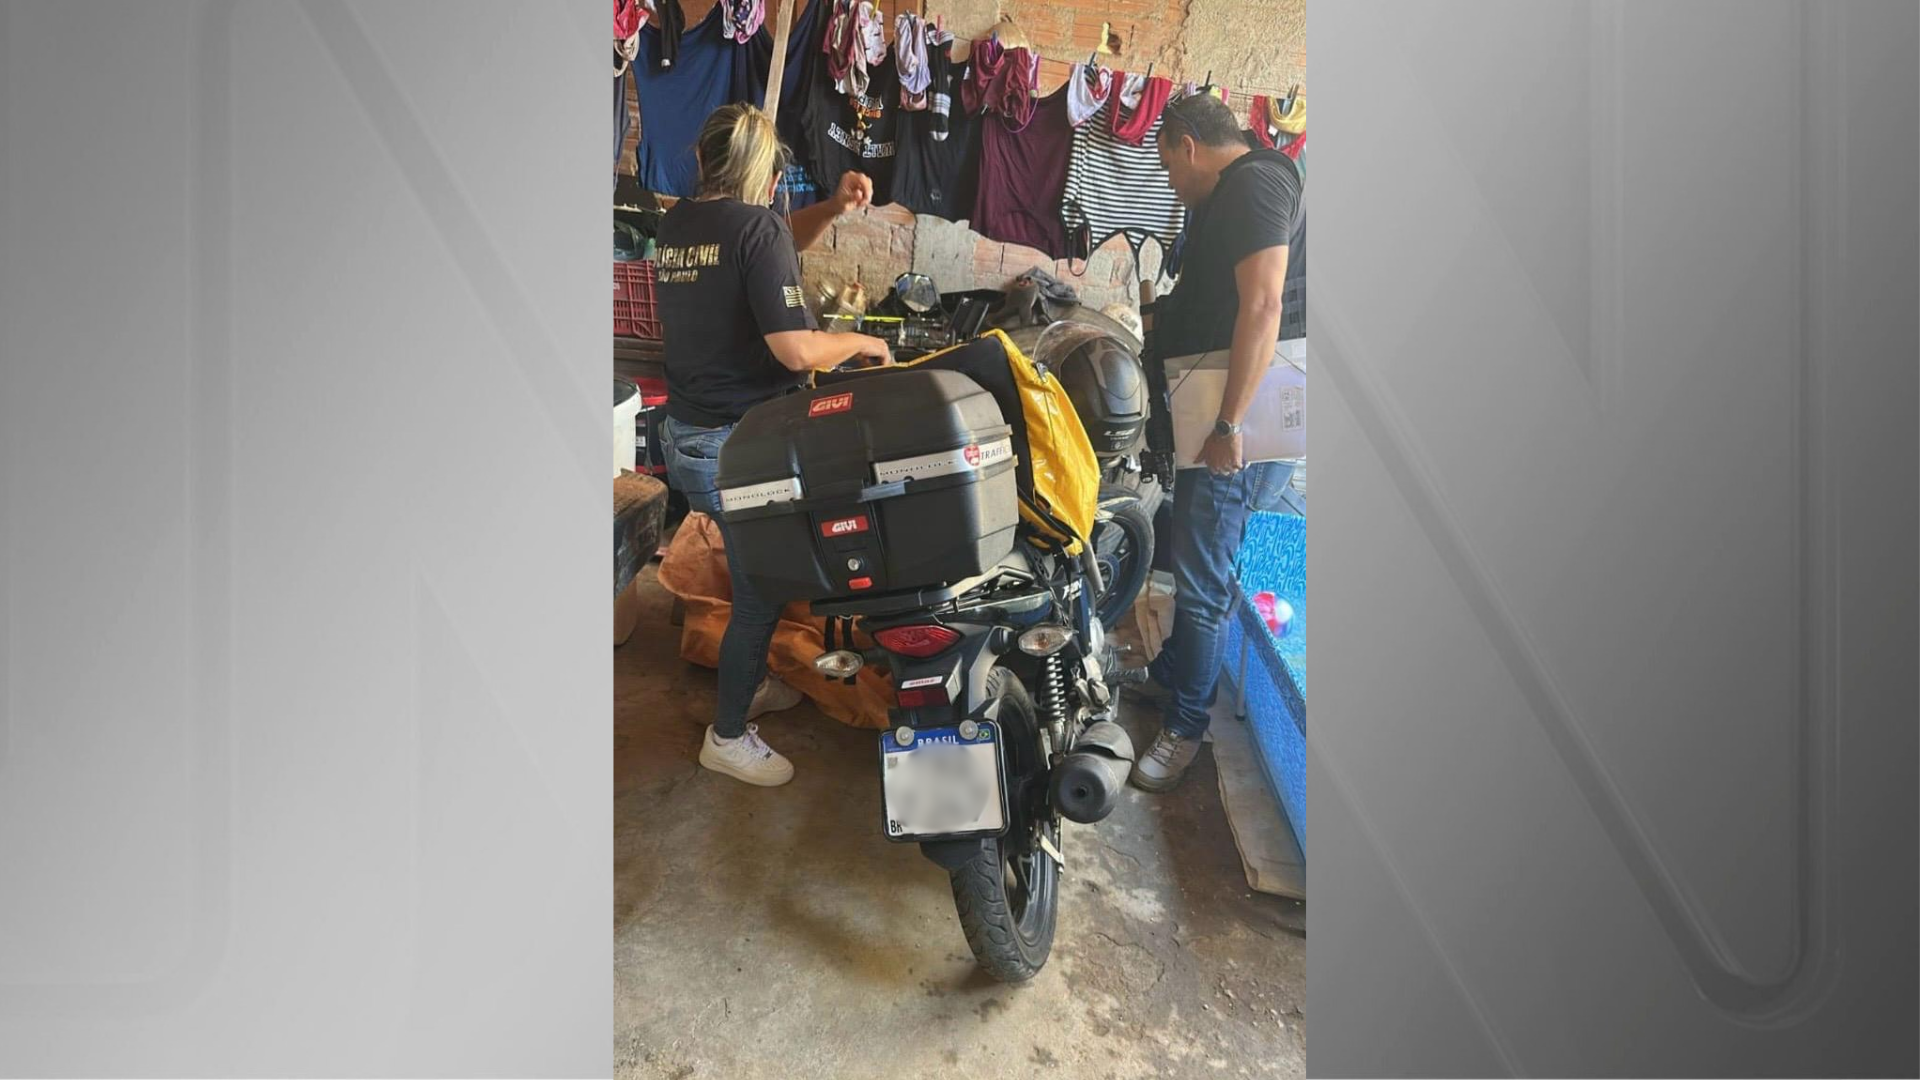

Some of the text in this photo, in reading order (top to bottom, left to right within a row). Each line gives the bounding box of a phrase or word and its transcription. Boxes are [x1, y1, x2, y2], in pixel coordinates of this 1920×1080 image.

[686, 243, 720, 267] CIVIL
[812, 396, 850, 412] GIVI
[831, 519, 857, 533] GIVI
[917, 735, 960, 747] BRASIL
